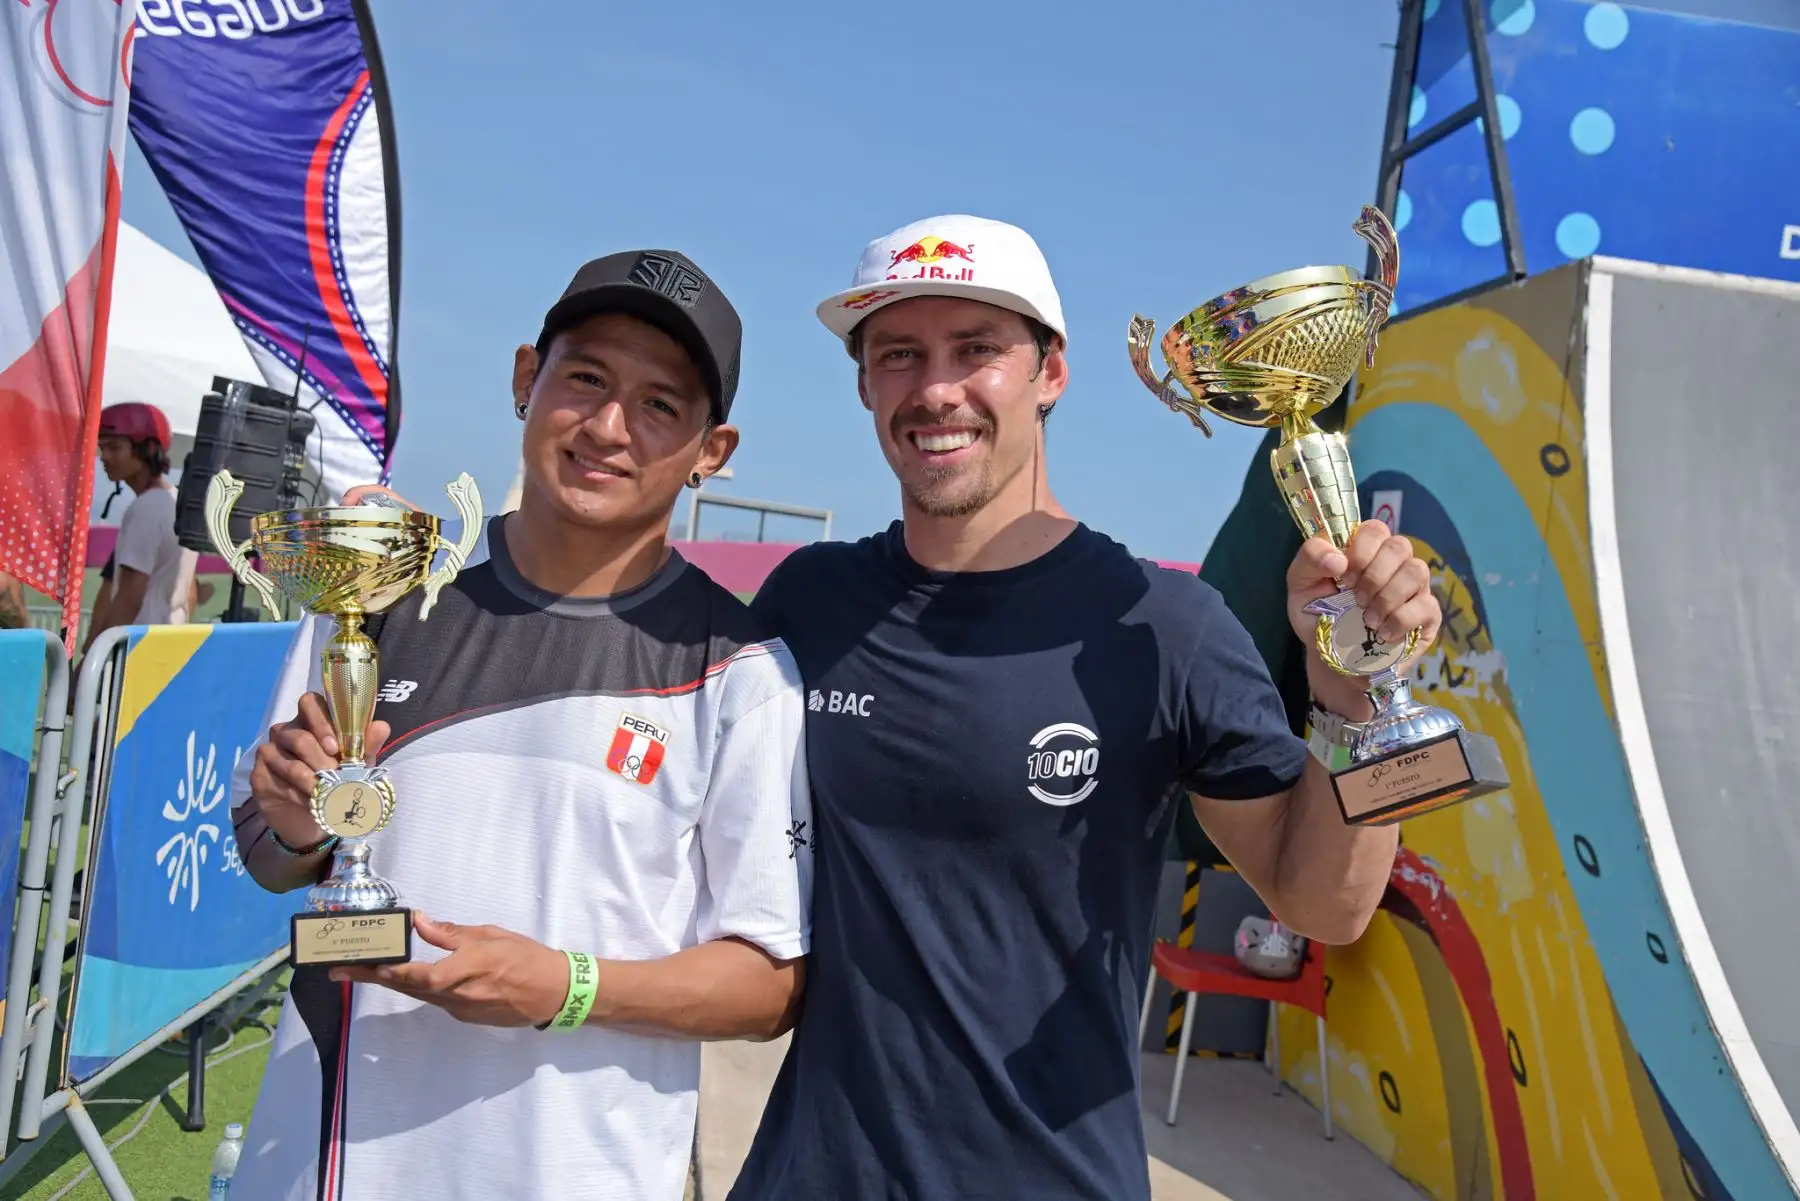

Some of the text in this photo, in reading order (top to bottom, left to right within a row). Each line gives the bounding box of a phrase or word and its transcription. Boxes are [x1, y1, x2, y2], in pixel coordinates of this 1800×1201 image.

[828, 690, 875, 717] BAC
[623, 716, 666, 742] PERU
[1396, 751, 1430, 768] FDPC
[1392, 773, 1421, 789] PUESTO
[351, 918, 387, 928] FDPC
